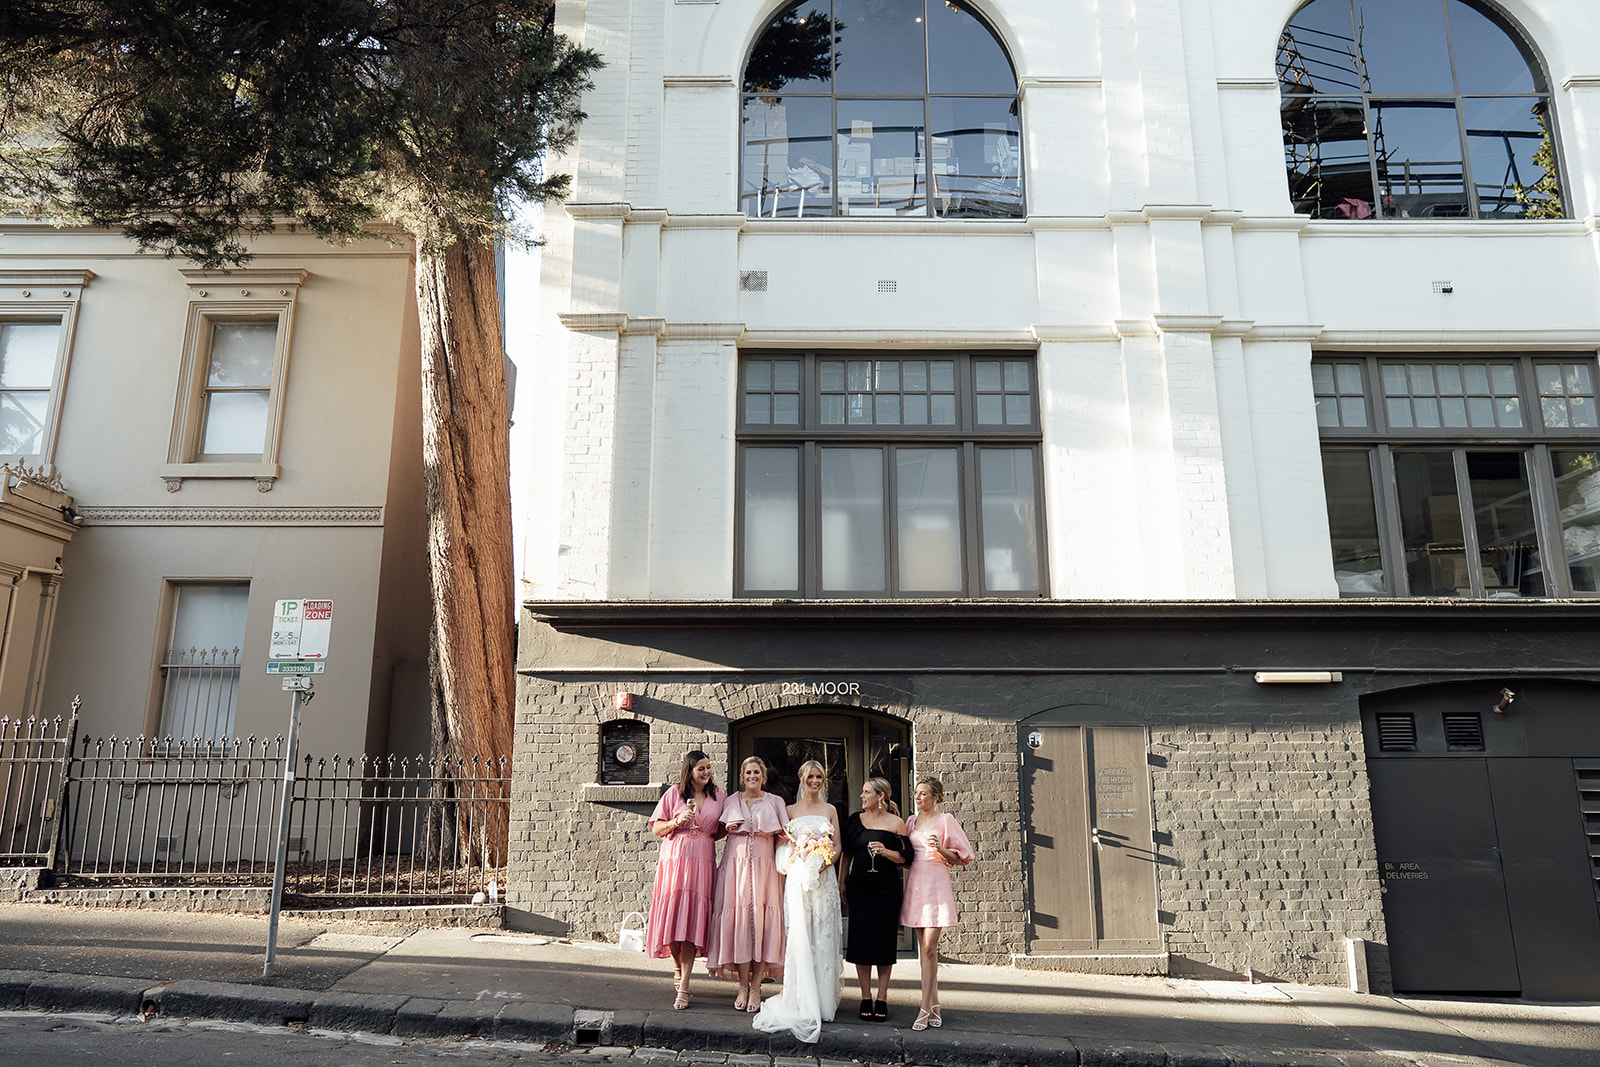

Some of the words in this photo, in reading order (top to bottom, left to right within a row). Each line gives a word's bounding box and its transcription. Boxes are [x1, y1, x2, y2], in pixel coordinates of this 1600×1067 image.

[282, 602, 298, 615] 1P
[306, 602, 332, 610] LOADING
[305, 611, 331, 619] ZONE
[782, 682, 805, 695] 231
[812, 682, 861, 695] MOOR
[1098, 776, 1110, 784] FIRE
[1110, 775, 1137, 784] HYDRANT
[1102, 784, 1133, 792] SPRINKLER
[1098, 792, 1124, 801] BOOSTER
[1399, 862, 1420, 870] AREA
[1386, 871, 1429, 880] DELIVERIES
